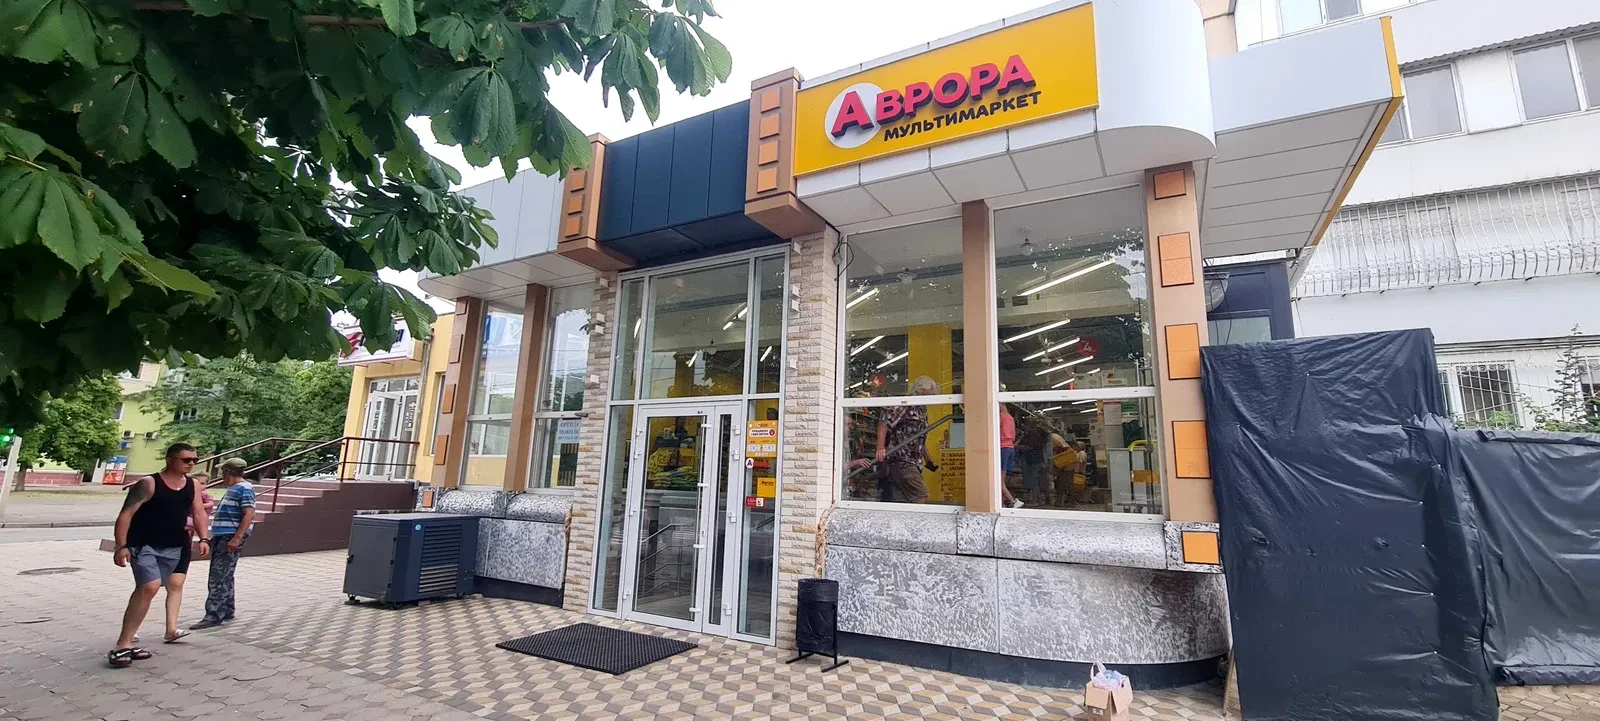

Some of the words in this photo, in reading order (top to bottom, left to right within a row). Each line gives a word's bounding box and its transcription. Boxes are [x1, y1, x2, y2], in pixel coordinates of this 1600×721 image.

[831, 53, 1036, 138] АВРОРА
[884, 90, 1042, 141] МУЛЬТИМАРКЕТ
[1083, 341, 1092, 352] 4
